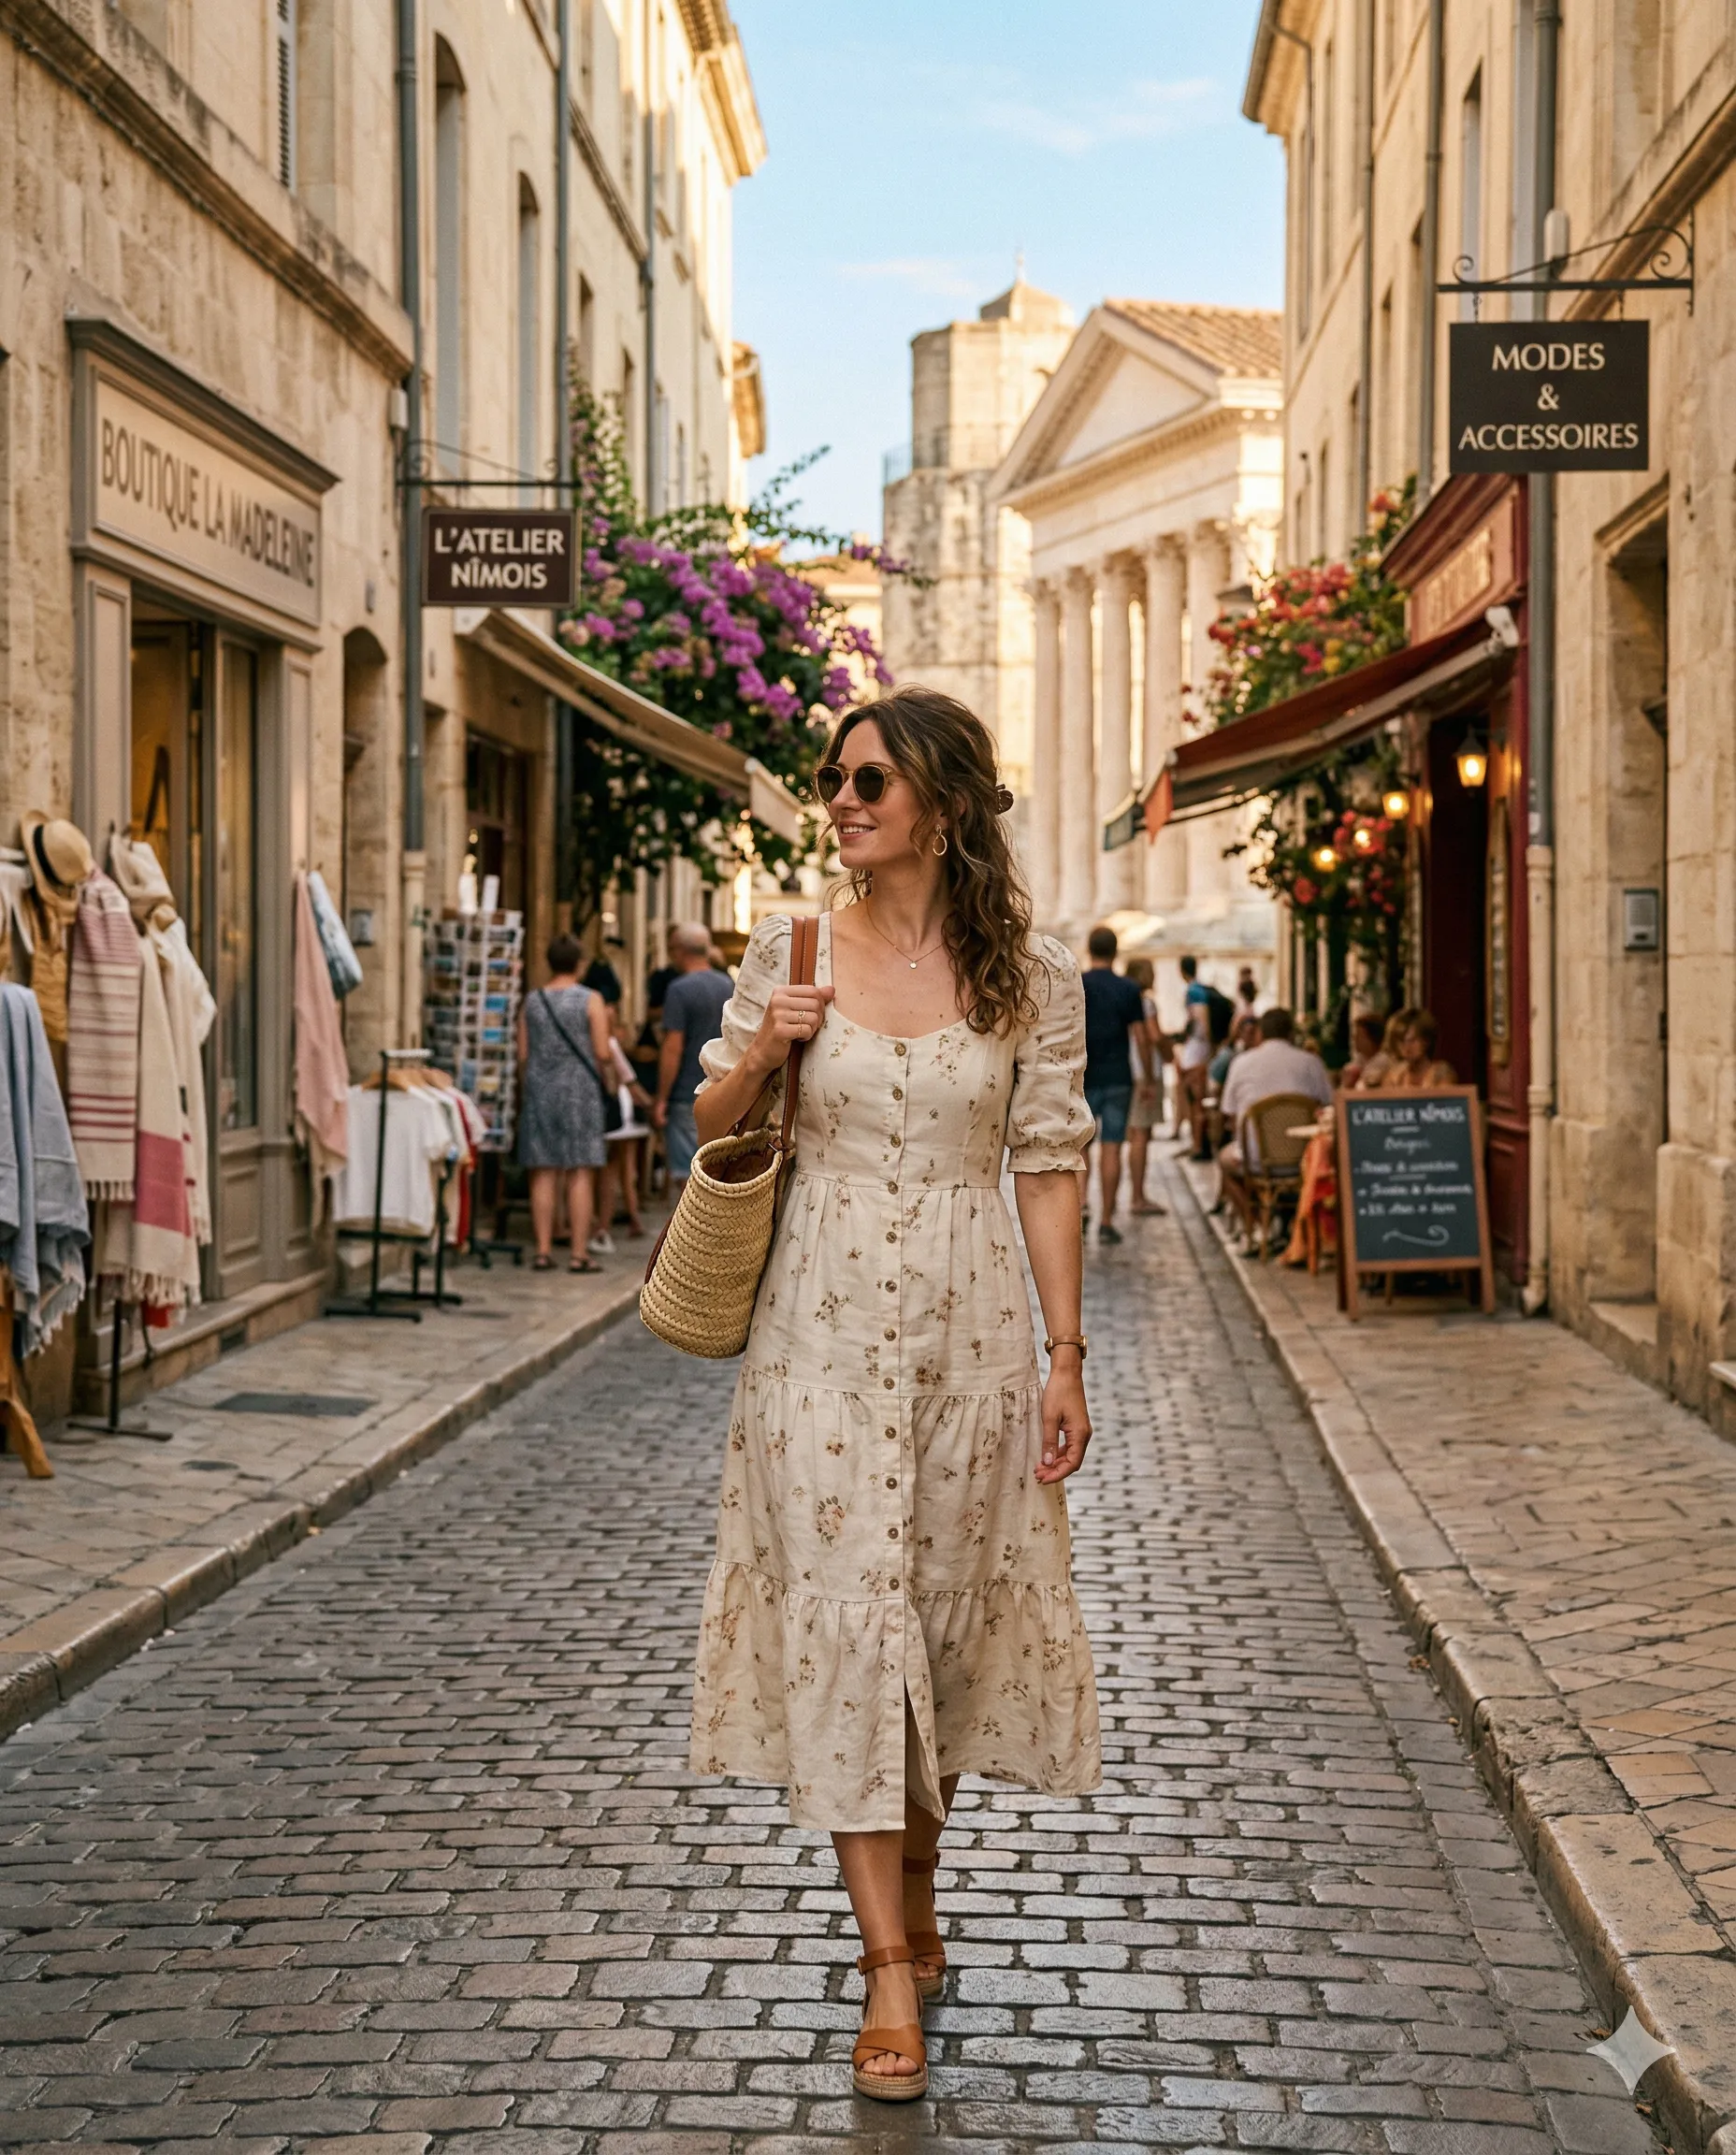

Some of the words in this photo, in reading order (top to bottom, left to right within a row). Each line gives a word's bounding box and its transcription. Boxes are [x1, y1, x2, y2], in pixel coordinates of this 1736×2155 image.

[1492, 342, 1606, 371] MODES
[1537, 383, 1560, 411] &
[1457, 423, 1640, 451] ACCESSOIRES
[102, 417, 199, 532] BOUTIQUE
[205, 474, 226, 544] LA
[435, 527, 565, 556] L'ATELIER
[451, 556, 548, 589] NÎMOIS
